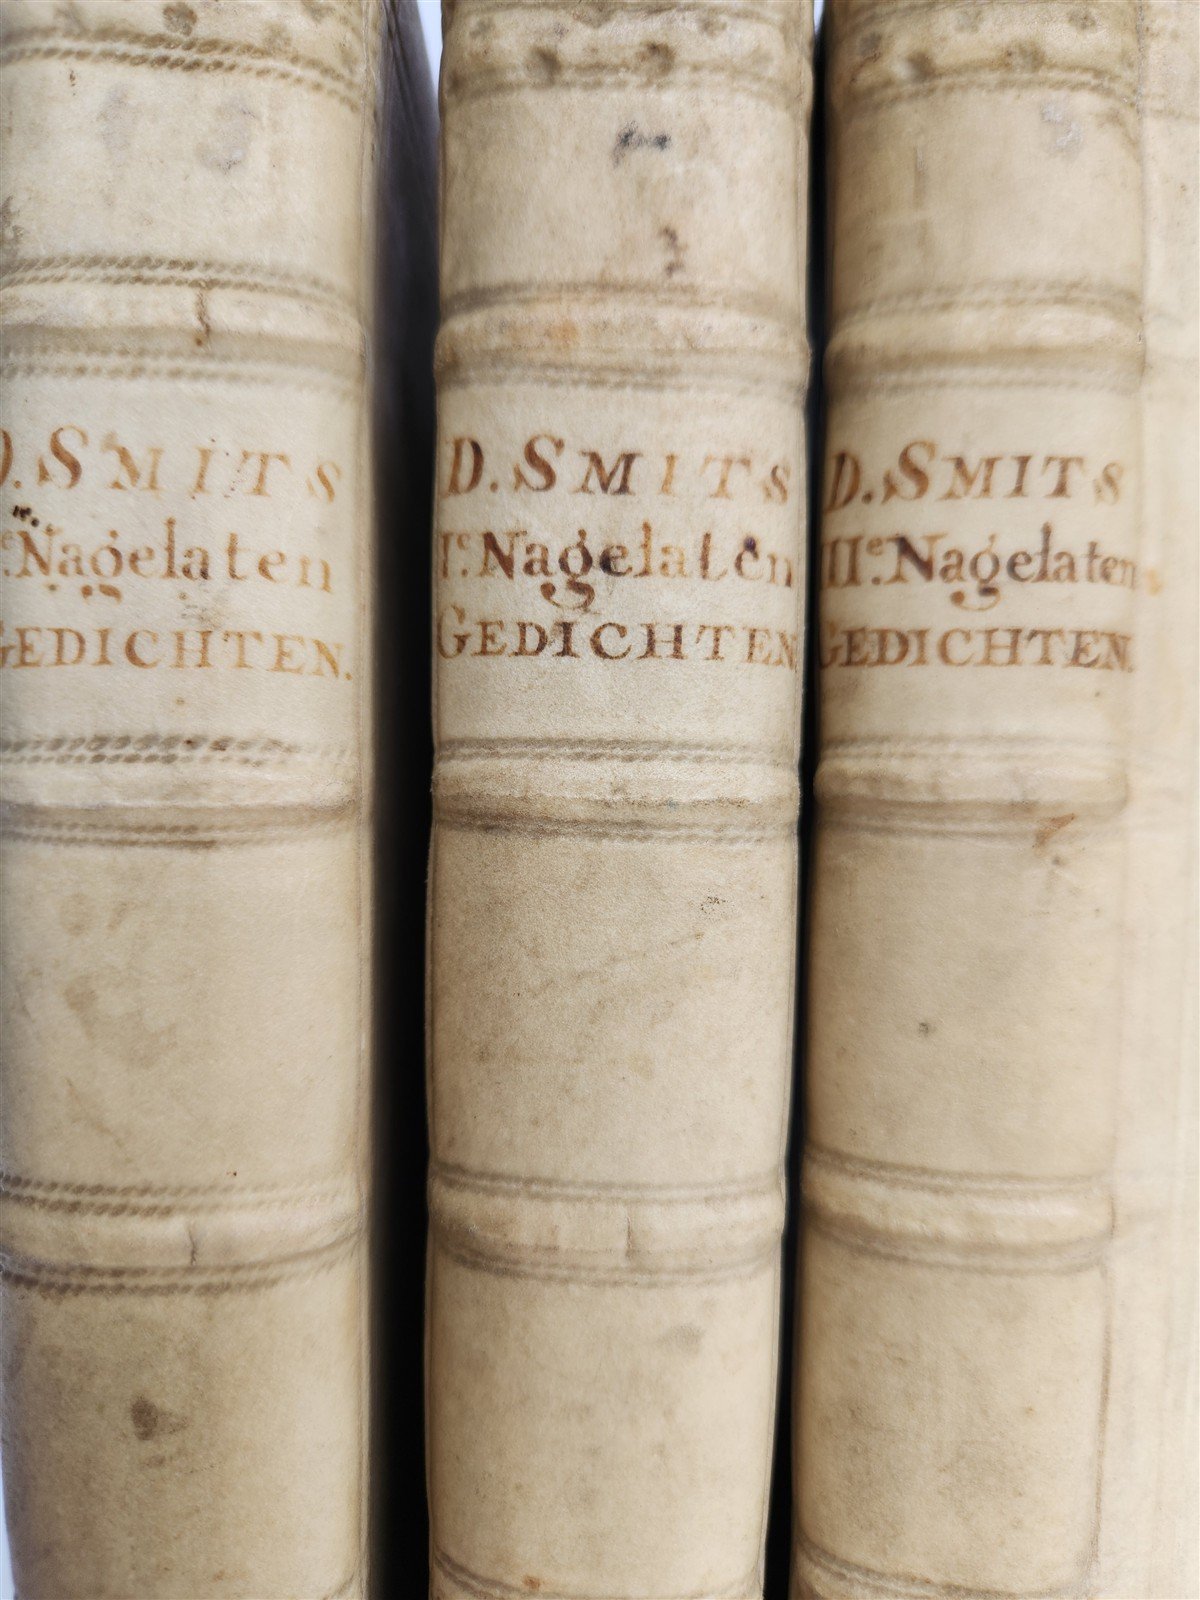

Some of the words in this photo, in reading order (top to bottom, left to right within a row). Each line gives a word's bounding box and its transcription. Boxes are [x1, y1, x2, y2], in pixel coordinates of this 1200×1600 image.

[37, 423, 343, 503] SMITS
[440, 436, 499, 497] D.
[512, 432, 792, 504] SMITS
[822, 449, 873, 514] D.
[880, 440, 1124, 506] SMITS
[15, 516, 334, 604] Nagelaten
[475, 521, 794, 613] Nagelaten
[885, 521, 1137, 611] Nagelaten
